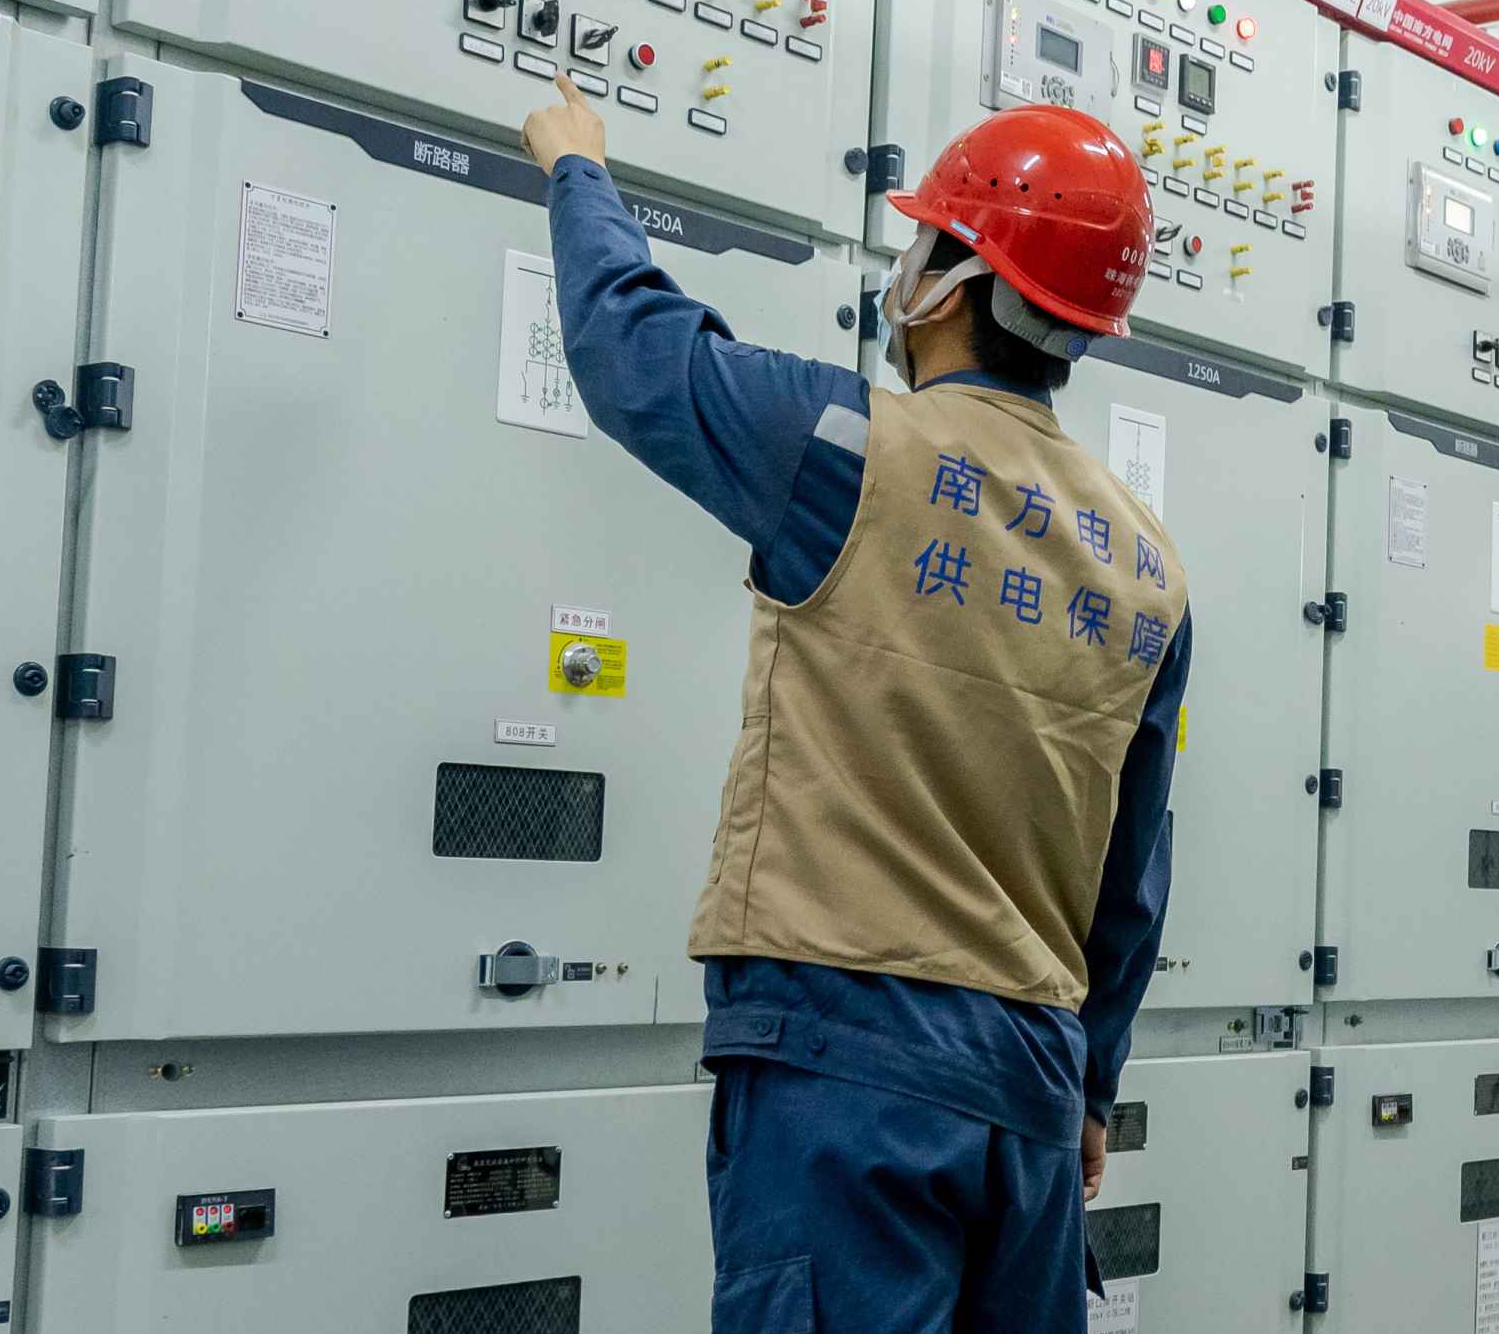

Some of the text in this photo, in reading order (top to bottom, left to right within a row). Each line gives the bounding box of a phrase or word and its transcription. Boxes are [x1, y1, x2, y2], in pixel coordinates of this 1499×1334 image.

[1463, 45, 1497, 74] 20kV
[413, 139, 470, 176] 断路器
[631, 204, 685, 236] 1250A
[1187, 362, 1221, 385] 1250A
[930, 452, 1167, 591] 南方电网
[913, 537, 1169, 669] 供电保障
